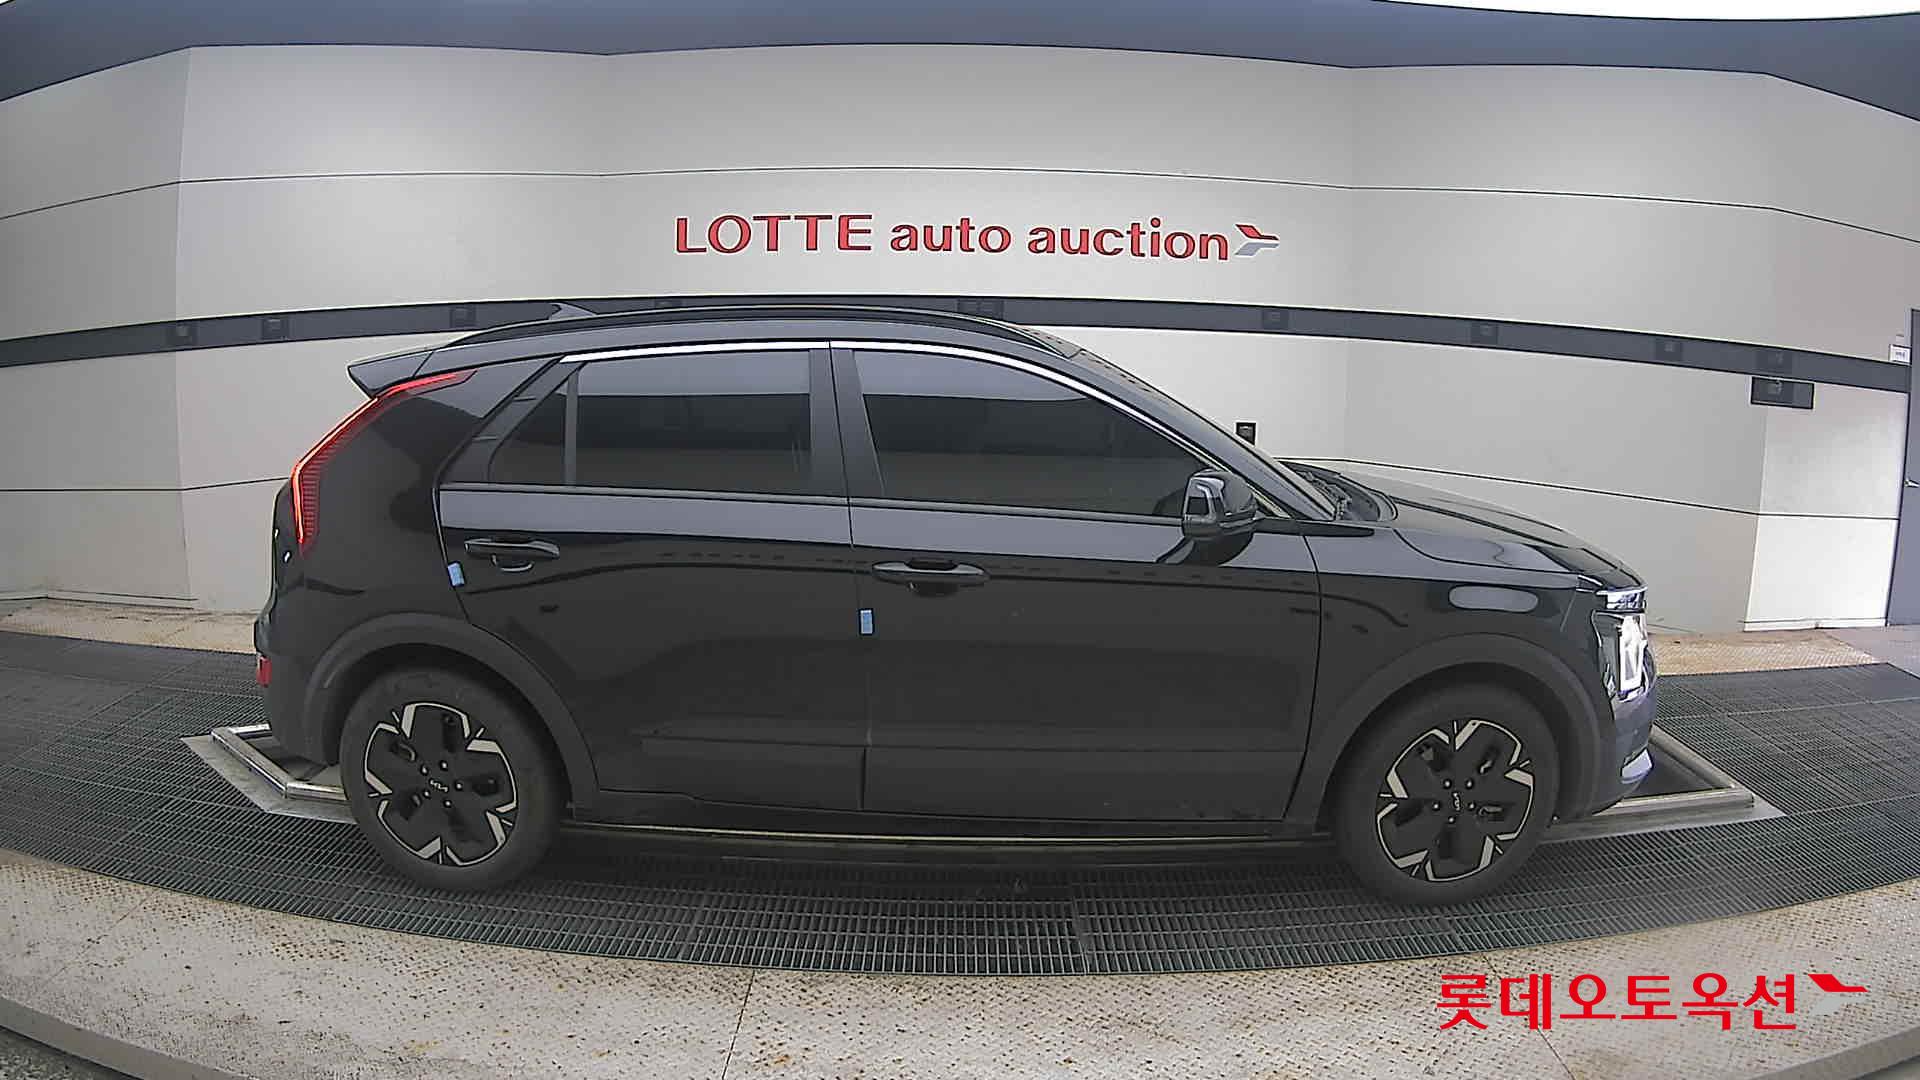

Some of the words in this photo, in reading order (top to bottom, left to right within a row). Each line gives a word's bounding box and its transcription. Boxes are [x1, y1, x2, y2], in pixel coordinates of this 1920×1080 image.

[676, 214, 873, 254] LOTTE
[890, 216, 1012, 253] auto
[1027, 218, 1230, 260] auction
